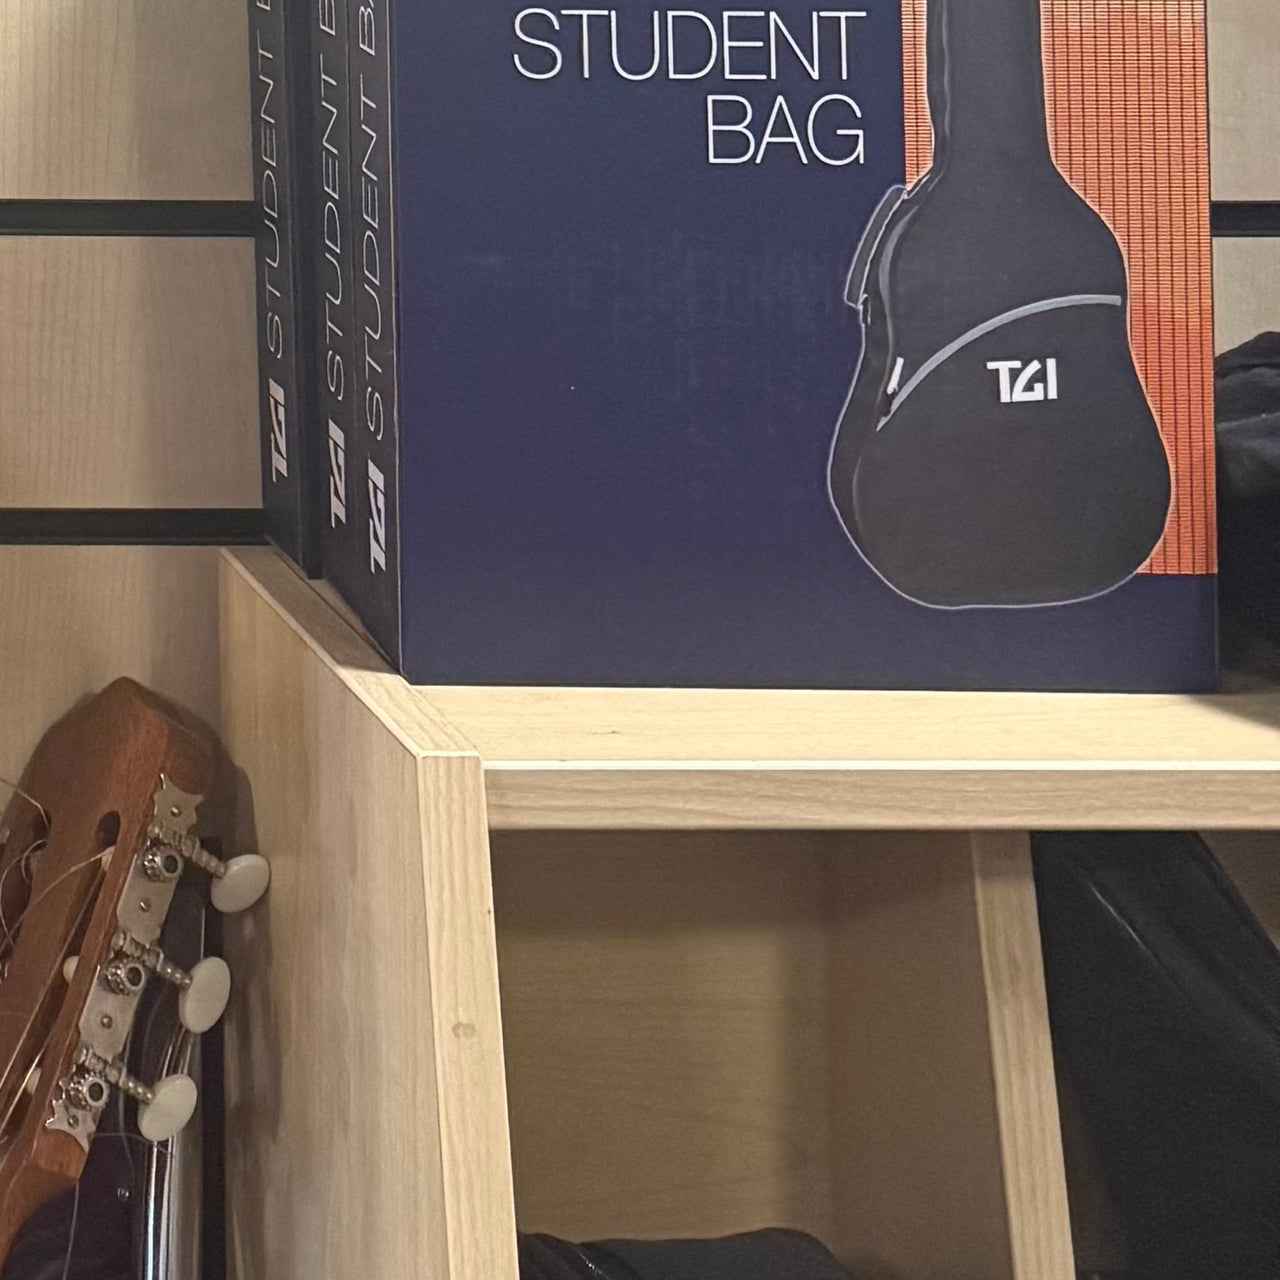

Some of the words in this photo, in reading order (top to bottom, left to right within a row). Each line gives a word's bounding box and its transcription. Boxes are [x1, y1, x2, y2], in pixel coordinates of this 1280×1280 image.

[513, 7, 867, 81] STUDENT
[706, 93, 865, 166] BAG
[255, 28, 283, 359] STUDENT
[319, 53, 345, 401] STUDENT
[359, 73, 384, 441] STUDENT
[986, 357, 1058, 403] TGI
